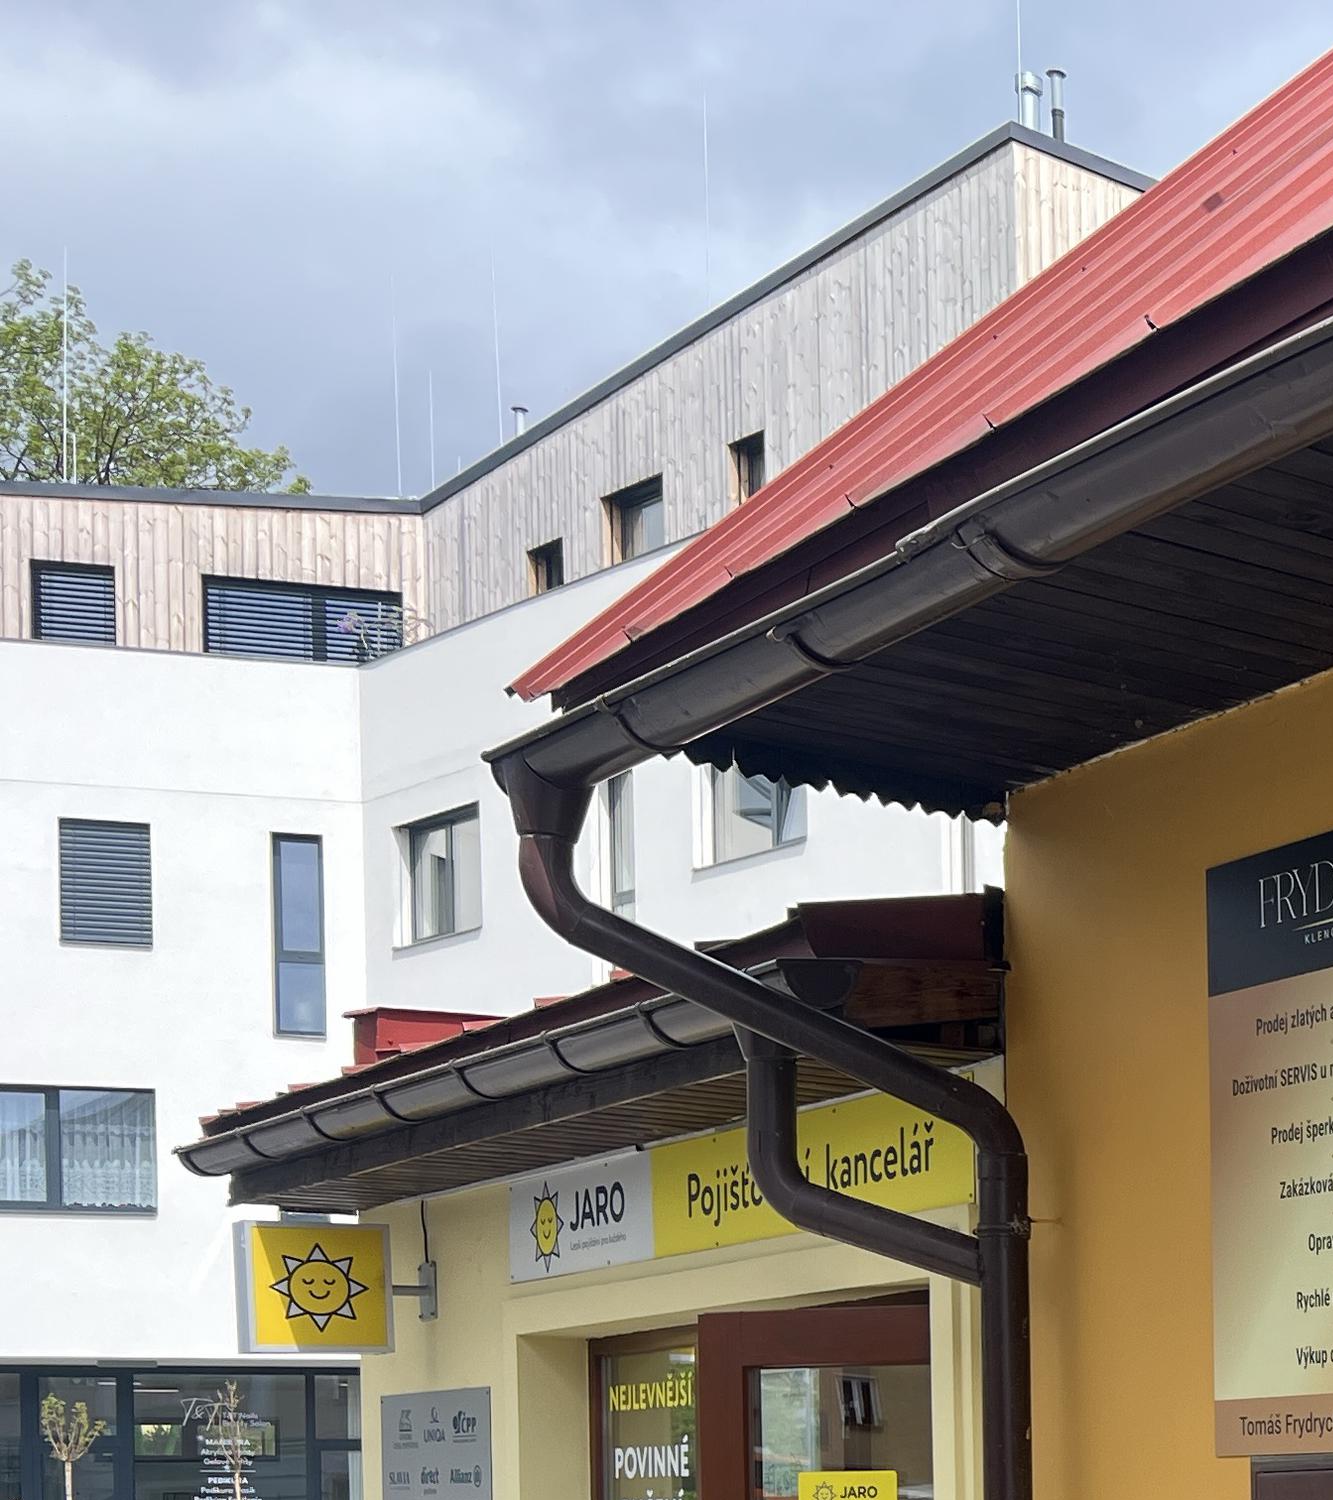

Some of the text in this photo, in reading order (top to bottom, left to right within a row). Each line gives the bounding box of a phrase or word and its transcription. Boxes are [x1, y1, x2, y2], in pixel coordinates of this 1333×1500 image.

[1256, 1015, 1288, 1036] Prodej
[1291, 1004, 1327, 1029] zlatých
[1232, 1069, 1278, 1096] Doživotní
[1280, 1063, 1318, 1087] SERVIS
[1321, 1066, 1327, 1079] u
[1271, 1122, 1304, 1145] Prodej
[825, 1121, 934, 1191] kancelář
[1279, 1173, 1333, 1200] Zakázková
[569, 1181, 625, 1231] JARO
[1296, 1288, 1330, 1313] Rychlé
[1296, 1346, 1328, 1369] Výkup
[609, 1372, 692, 1411] NEJLEVNĚJŠÍ
[1239, 1414, 1282, 1436] Tomáš
[614, 1434, 690, 1480] POVINNÉ
[840, 1486, 878, 1499] JARO
